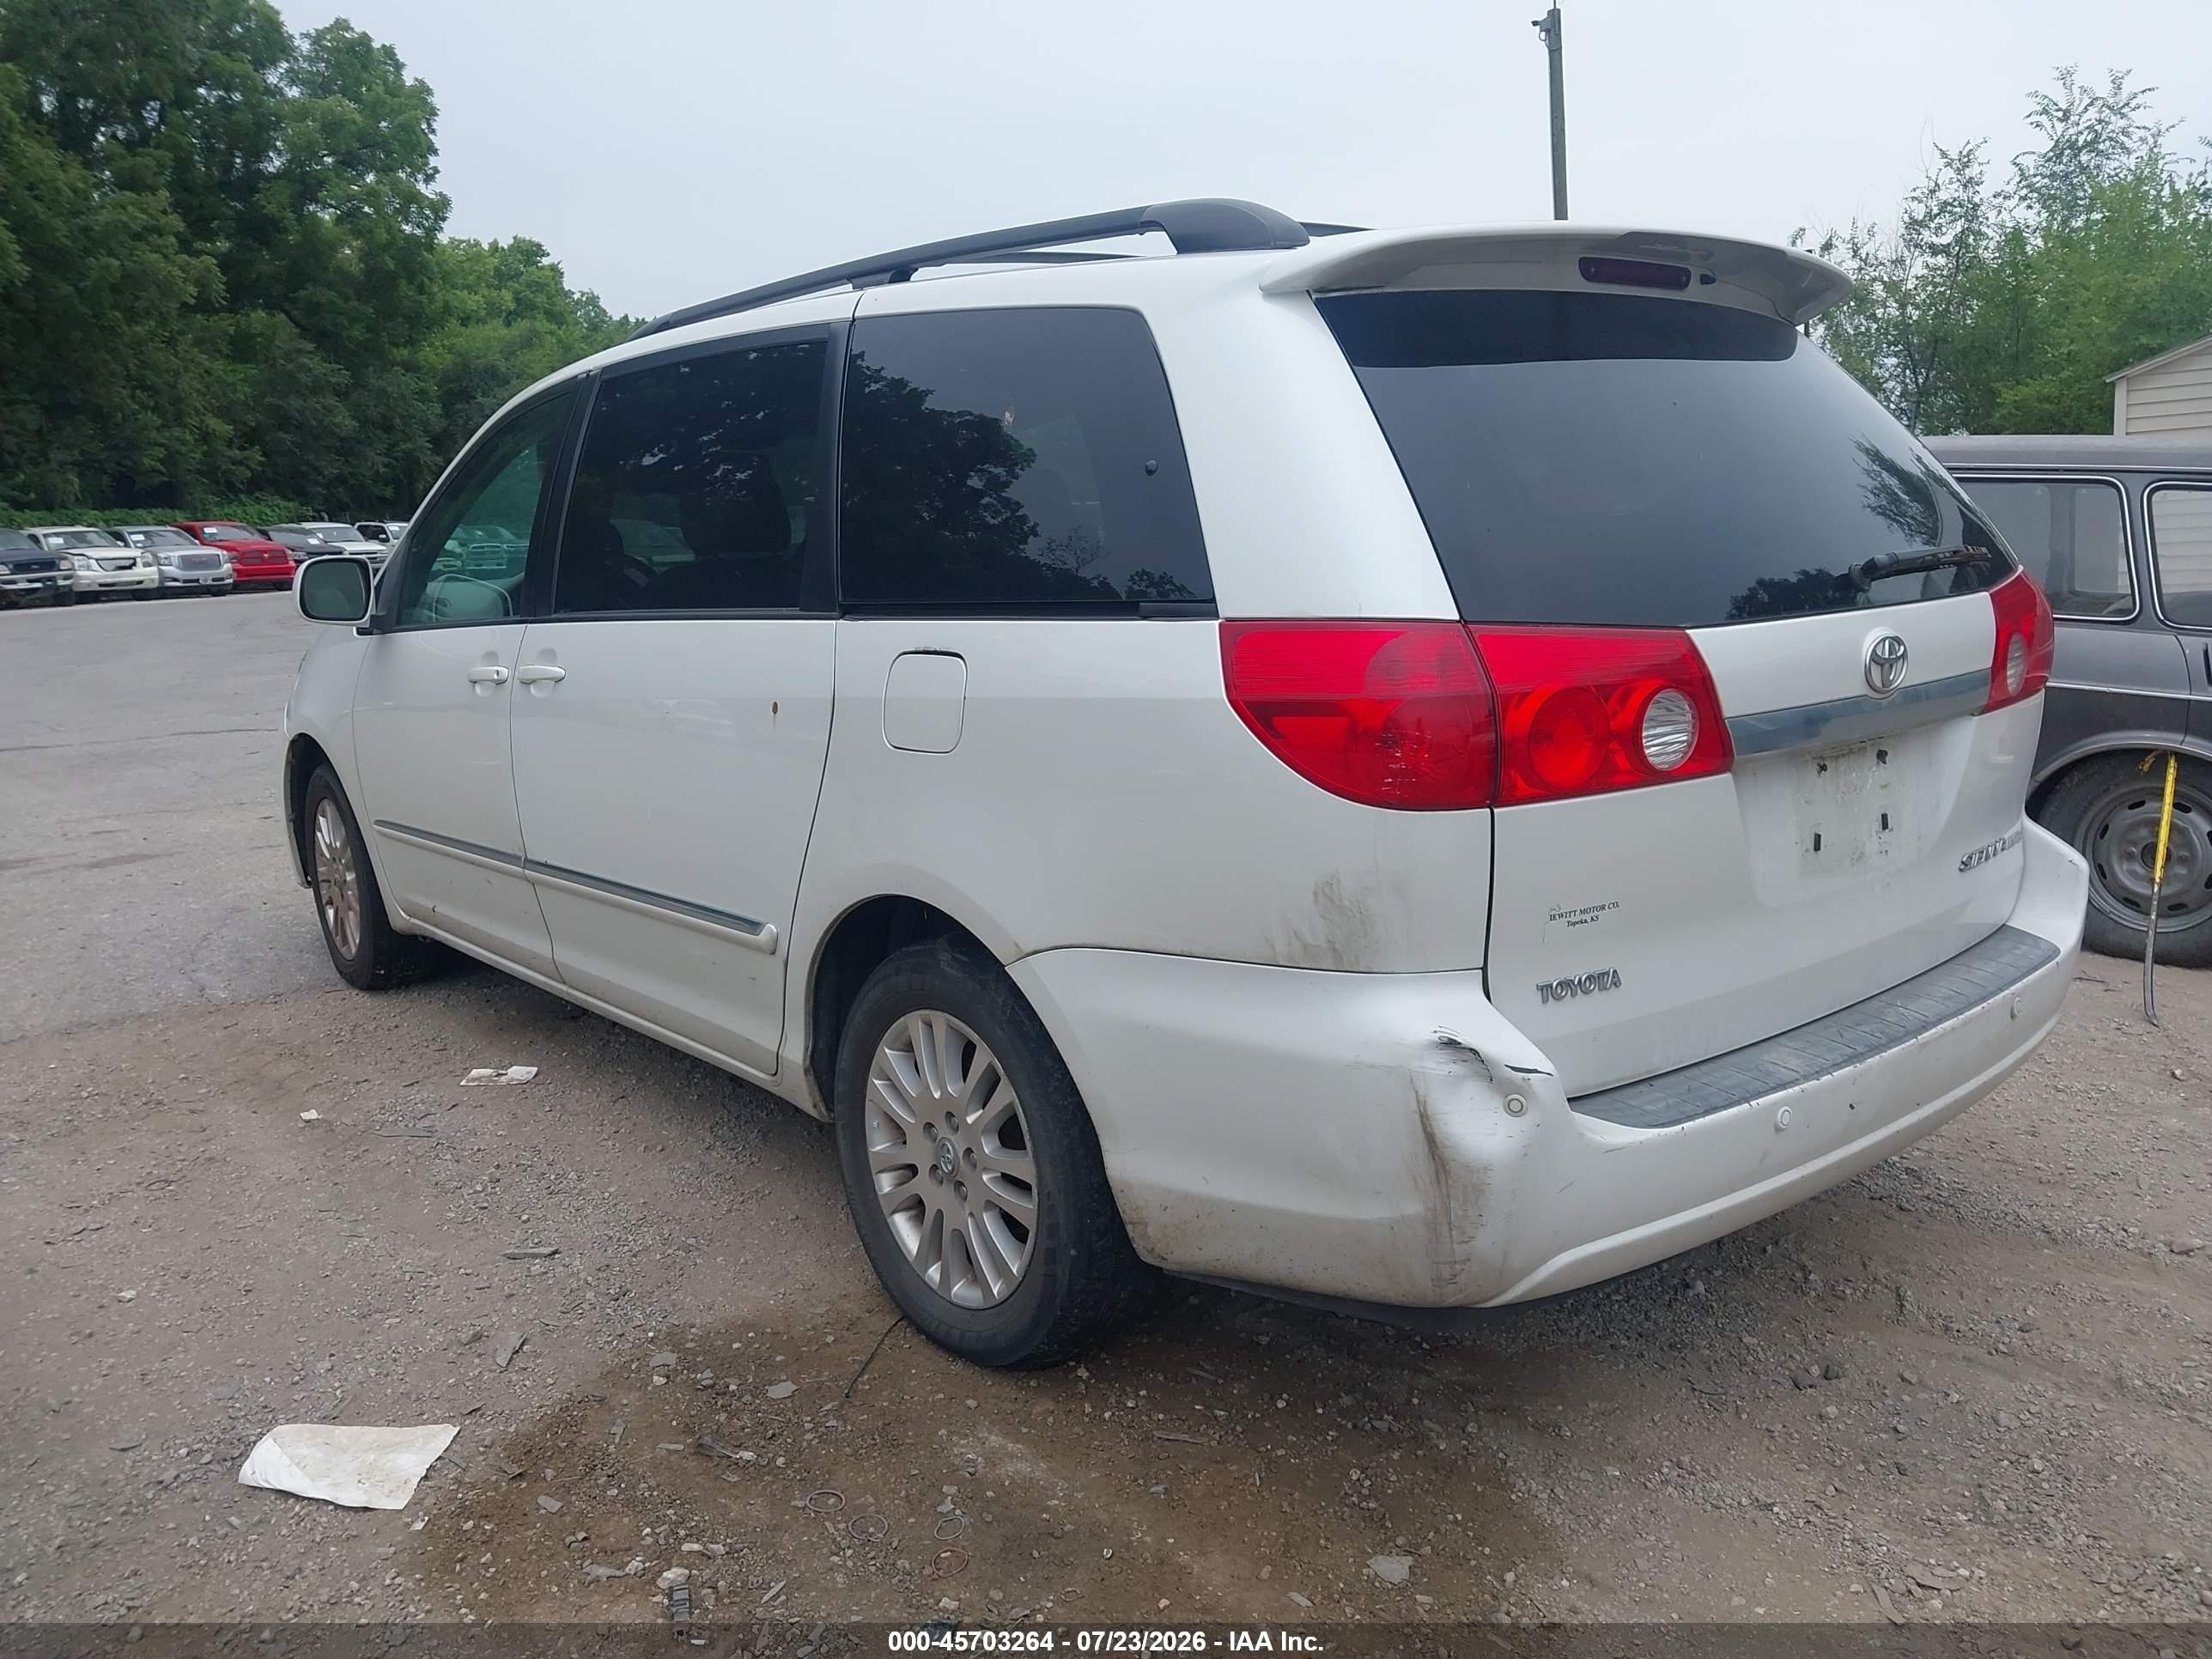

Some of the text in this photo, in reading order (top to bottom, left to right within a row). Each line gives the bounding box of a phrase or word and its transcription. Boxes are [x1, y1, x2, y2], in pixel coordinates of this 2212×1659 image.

[1579, 903, 1607, 916] MOTOR
[1590, 915, 1600, 923] KS
[1535, 967, 1622, 1004] TOYOTA
